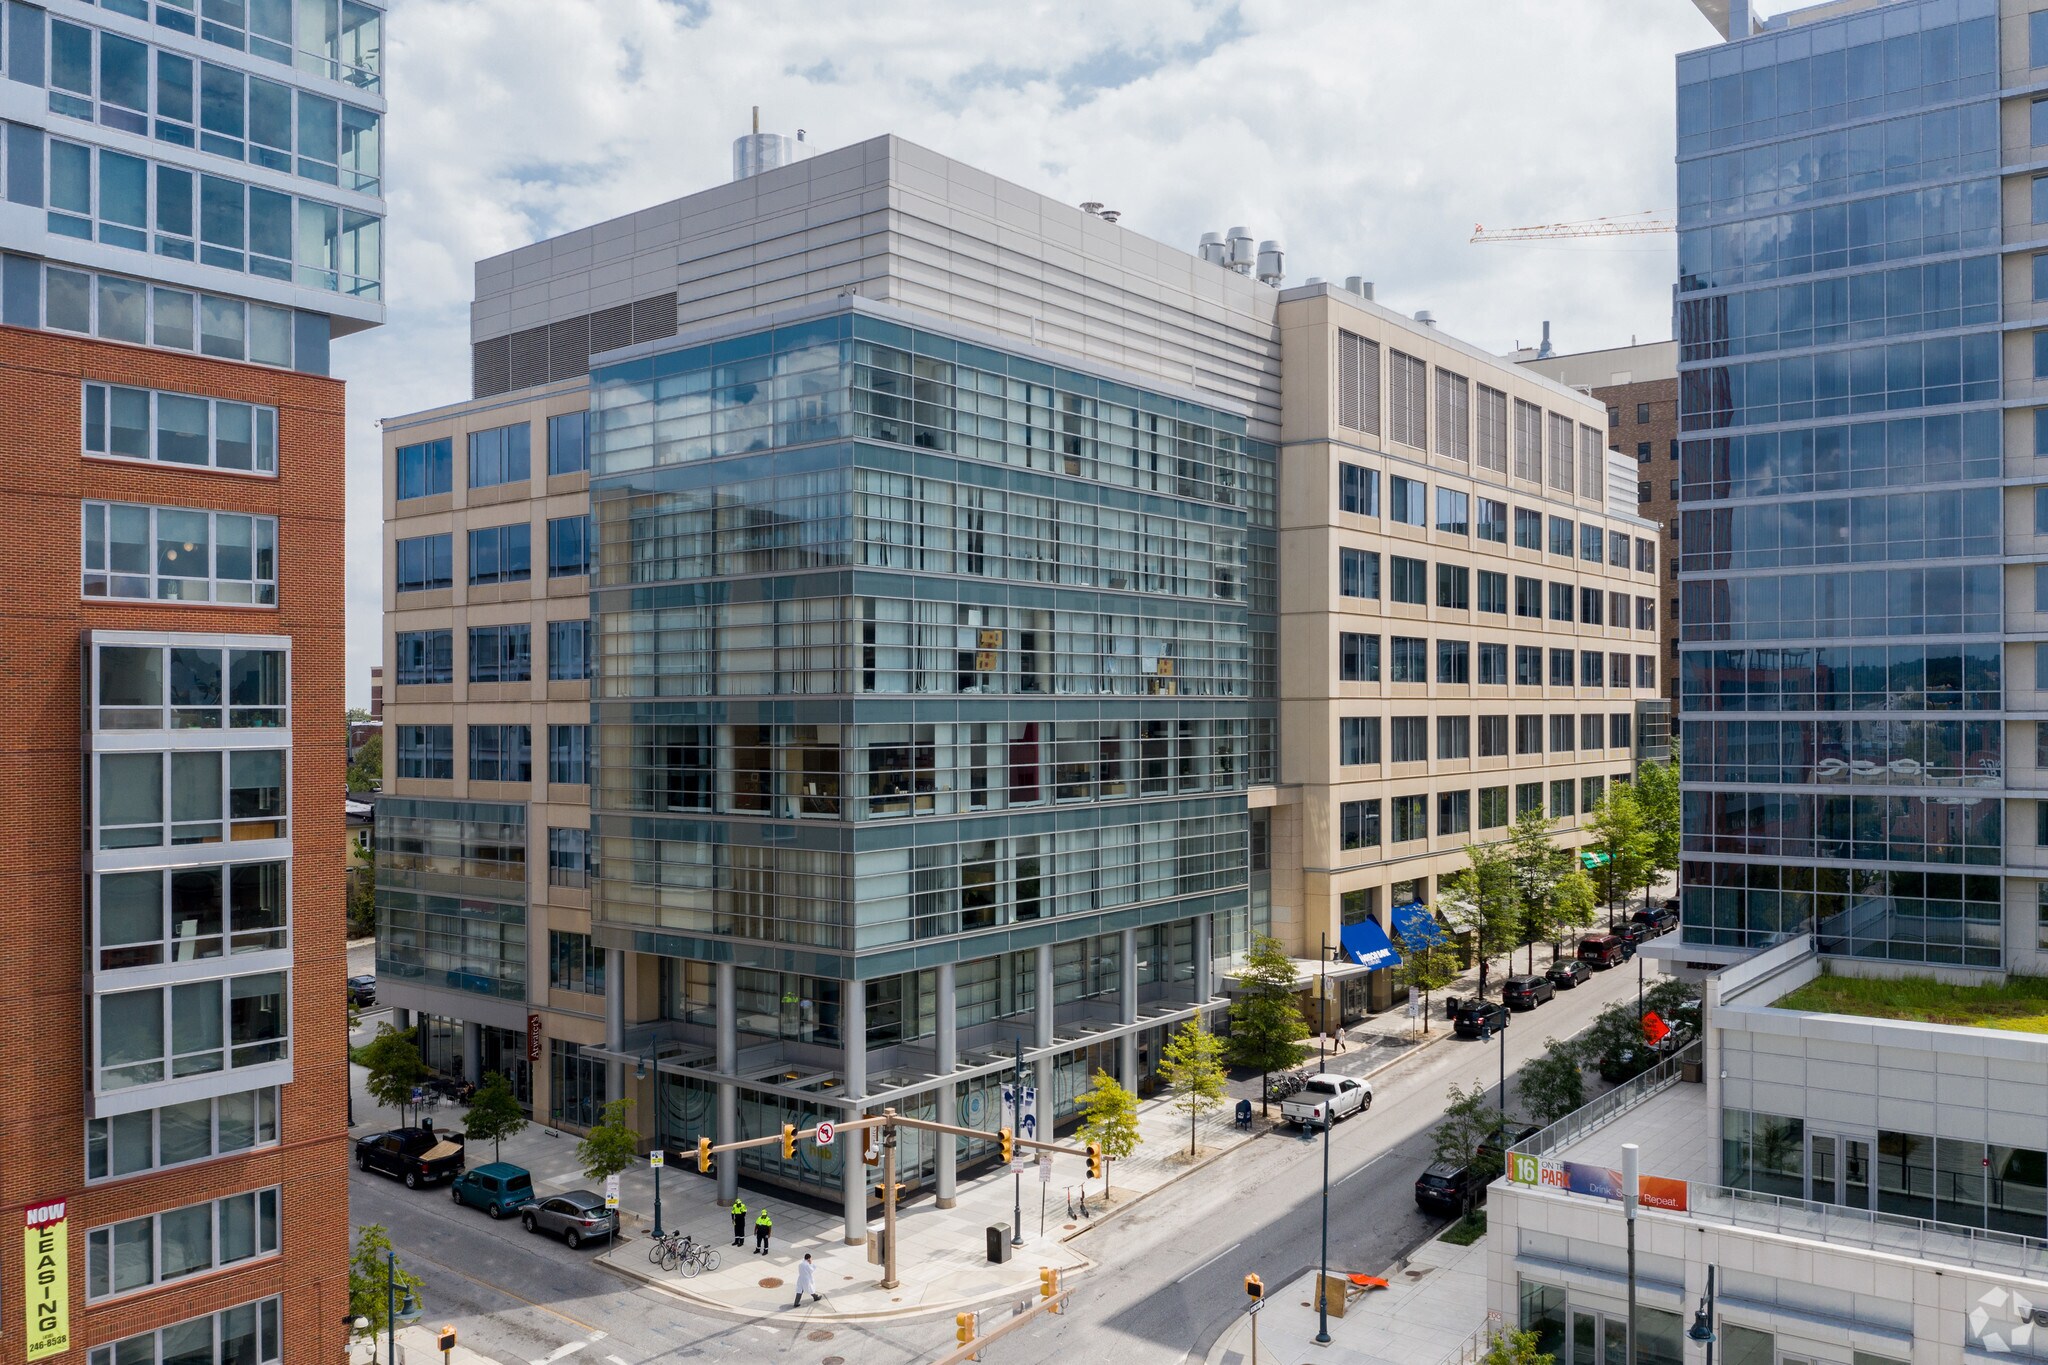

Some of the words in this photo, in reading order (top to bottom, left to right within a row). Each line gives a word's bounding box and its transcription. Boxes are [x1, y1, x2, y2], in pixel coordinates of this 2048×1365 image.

[1517, 1156, 1535, 1182] 16
[1541, 1161, 1554, 1169] ON
[1555, 1162, 1571, 1172] THE
[1541, 1168, 1571, 1189] PARK
[1644, 1193, 1678, 1207] Repeat.
[27, 1202, 65, 1225] NOW
[37, 1226, 57, 1332] LEASING
[29, 1335, 67, 1352] 246-8538
